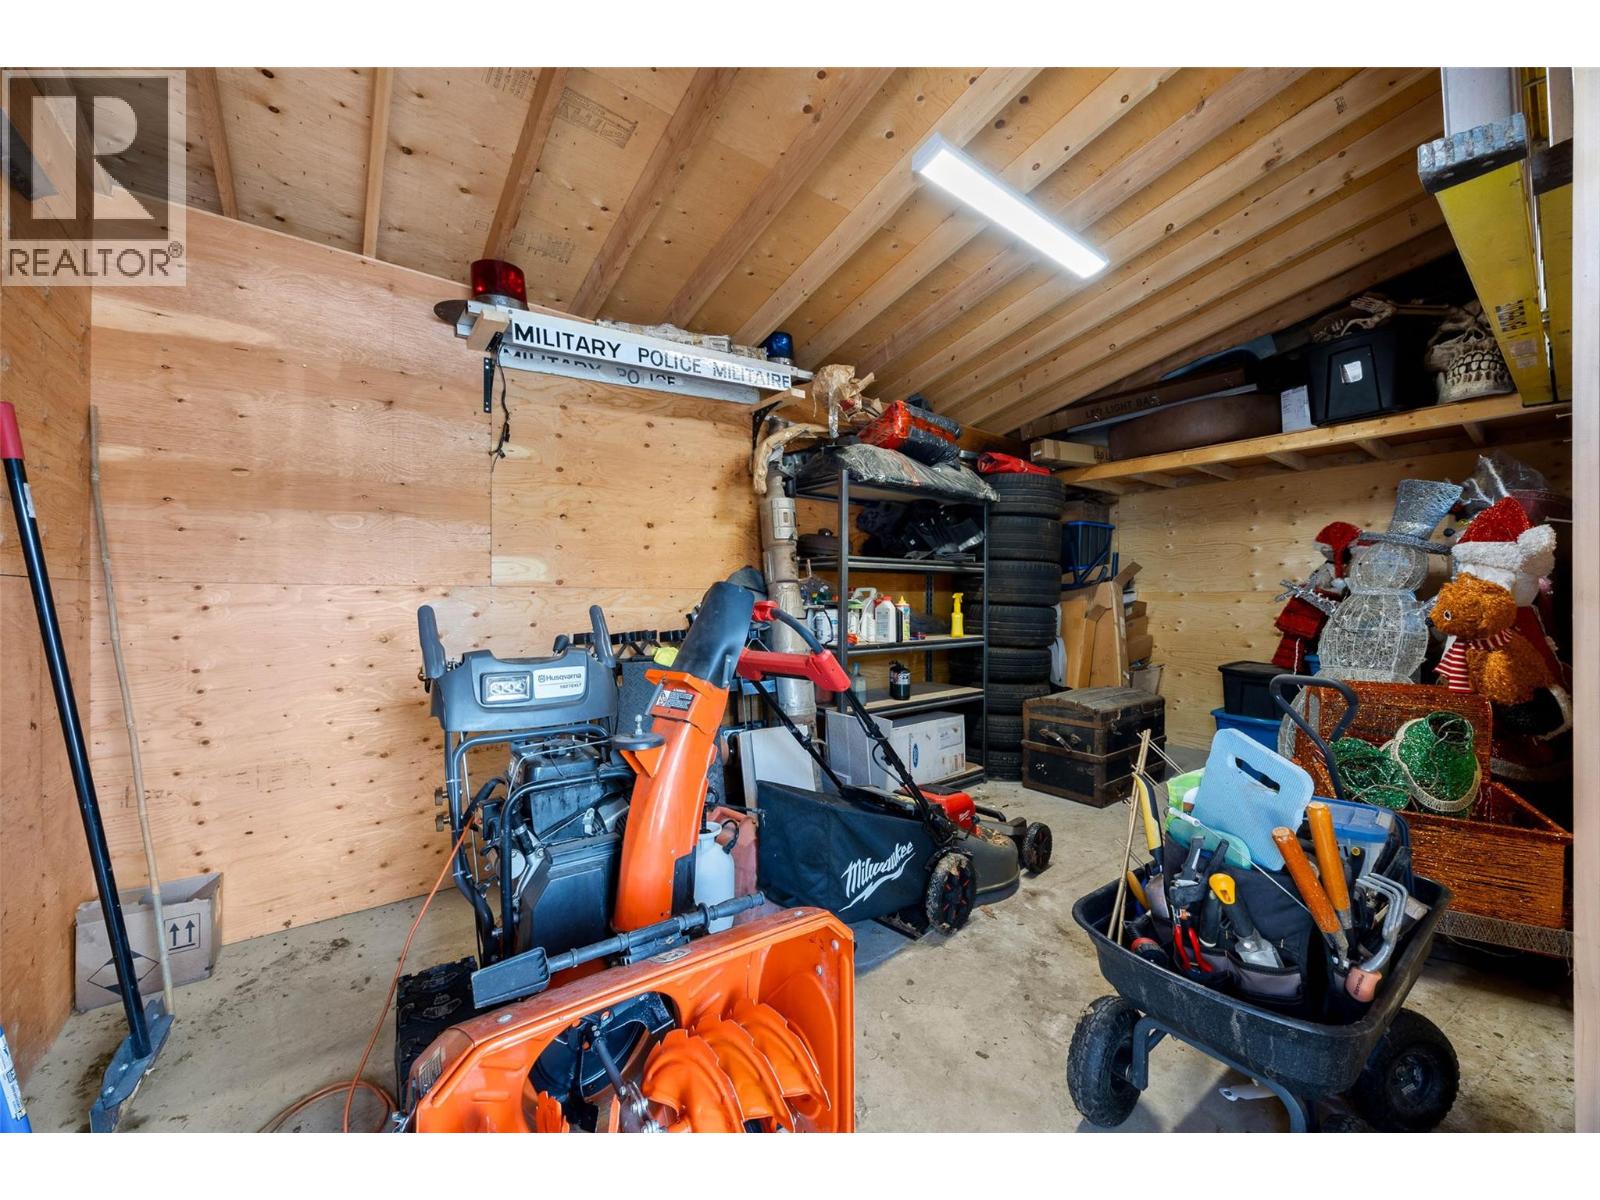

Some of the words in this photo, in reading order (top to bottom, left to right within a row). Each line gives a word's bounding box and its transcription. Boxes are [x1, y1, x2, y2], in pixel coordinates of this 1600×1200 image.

[514, 324, 621, 359] MILITARY
[638, 346, 703, 375] POLICE
[712, 362, 792, 389] MILITAIRE
[546, 672, 582, 682] Husqvarna
[841, 841, 914, 899] Milwaukee
